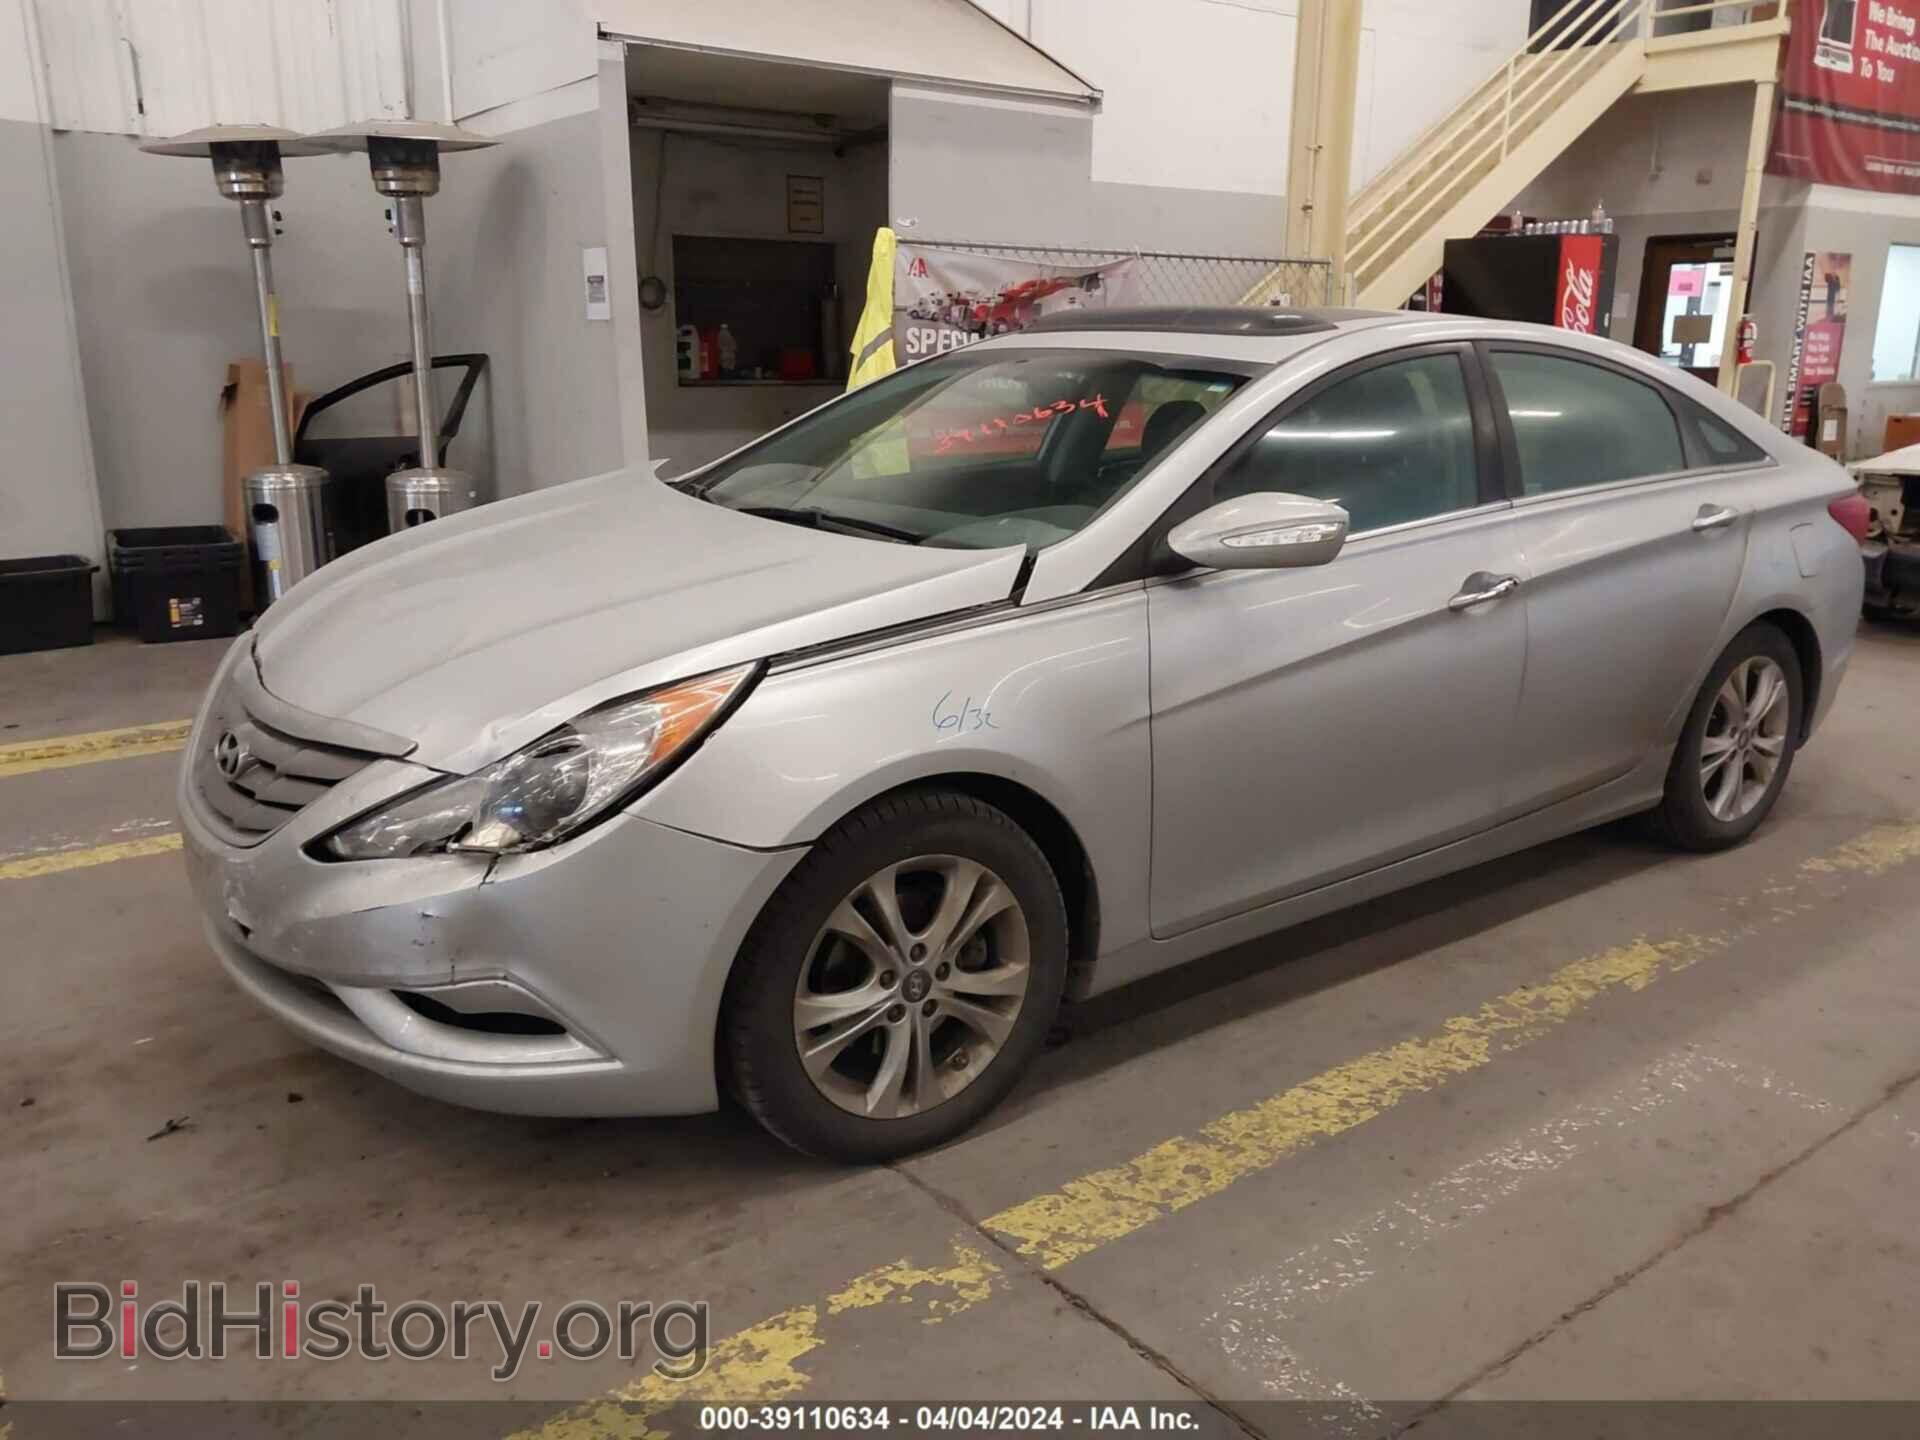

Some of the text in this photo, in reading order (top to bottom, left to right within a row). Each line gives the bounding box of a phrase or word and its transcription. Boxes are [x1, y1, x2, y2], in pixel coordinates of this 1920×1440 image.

[1865, 28, 1884, 52] The
[1861, 56, 1895, 83] To You
[1787, 339, 1803, 392] SMART
[1796, 289, 1809, 332] WITH
[1803, 257, 1814, 285] IAA
